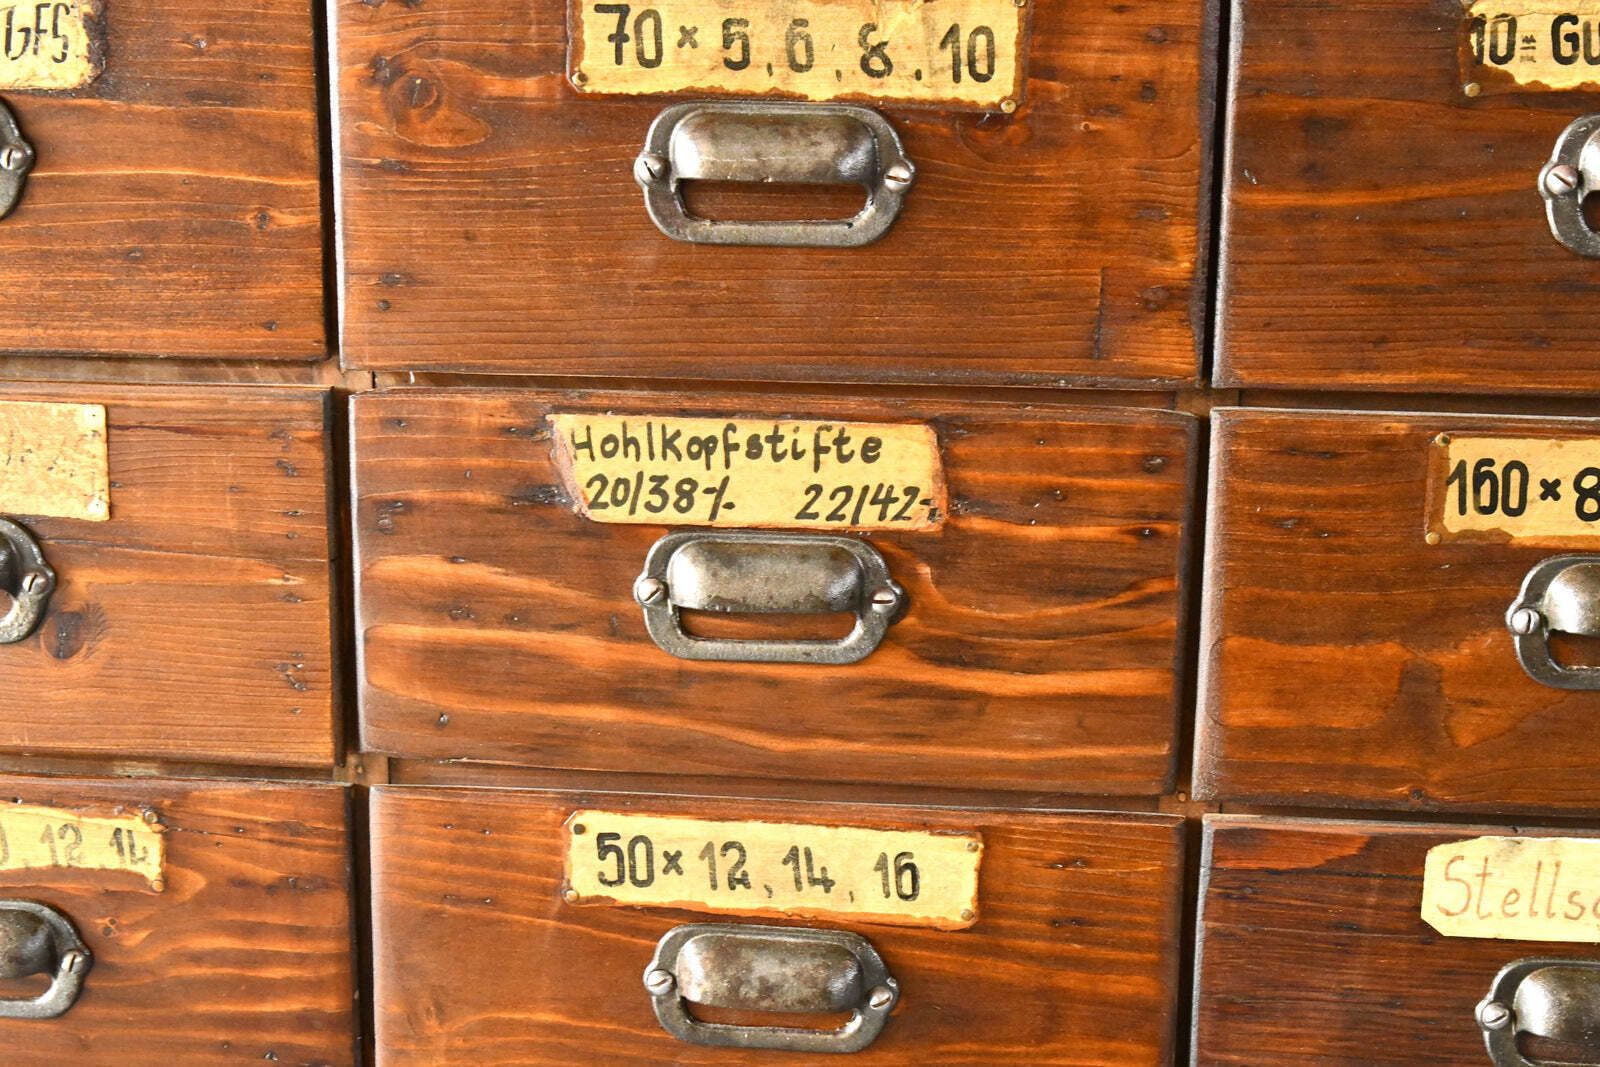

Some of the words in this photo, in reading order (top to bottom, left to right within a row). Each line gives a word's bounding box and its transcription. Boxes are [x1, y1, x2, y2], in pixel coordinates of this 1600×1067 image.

[594, 4, 663, 68] 70
[939, 23, 995, 83] 10
[571, 421, 882, 473] Hohlkopfstifte
[597, 832, 654, 888] 50
[873, 851, 920, 901] 16
